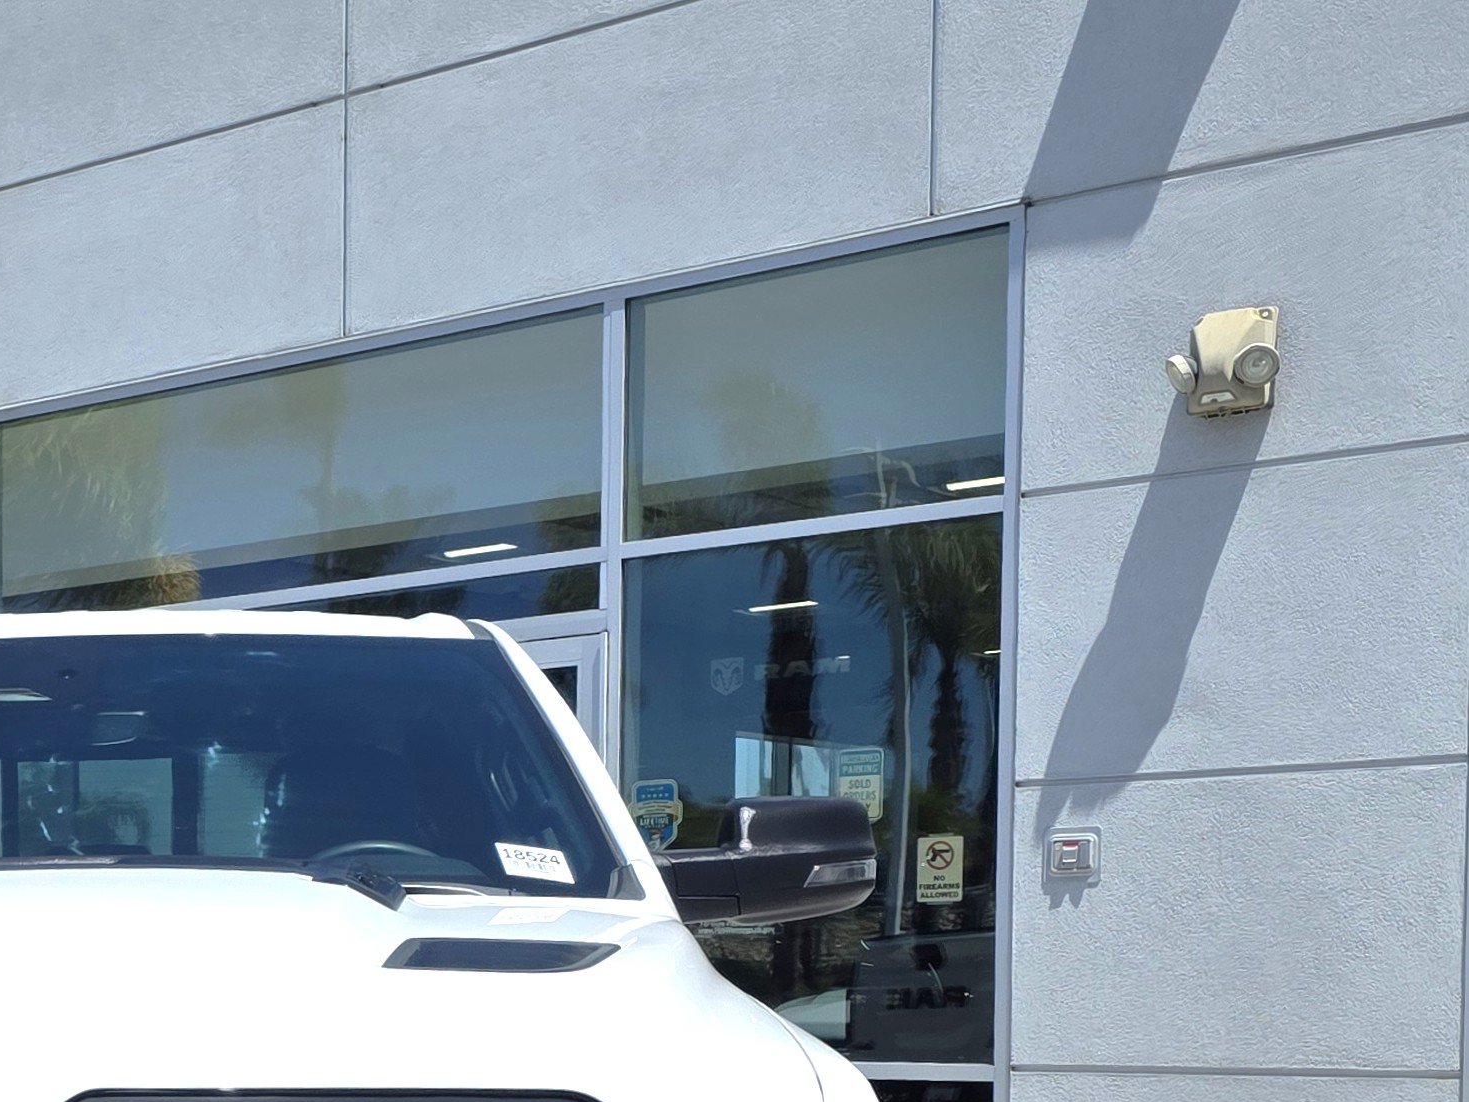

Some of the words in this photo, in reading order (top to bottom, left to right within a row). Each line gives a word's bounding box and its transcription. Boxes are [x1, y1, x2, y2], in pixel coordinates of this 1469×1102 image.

[847, 779, 872, 790] SOLD
[503, 848, 561, 865] 18524
[933, 874, 946, 882] NO
[918, 882, 961, 890] FIREARMS
[920, 890, 960, 899] ALLOWED
